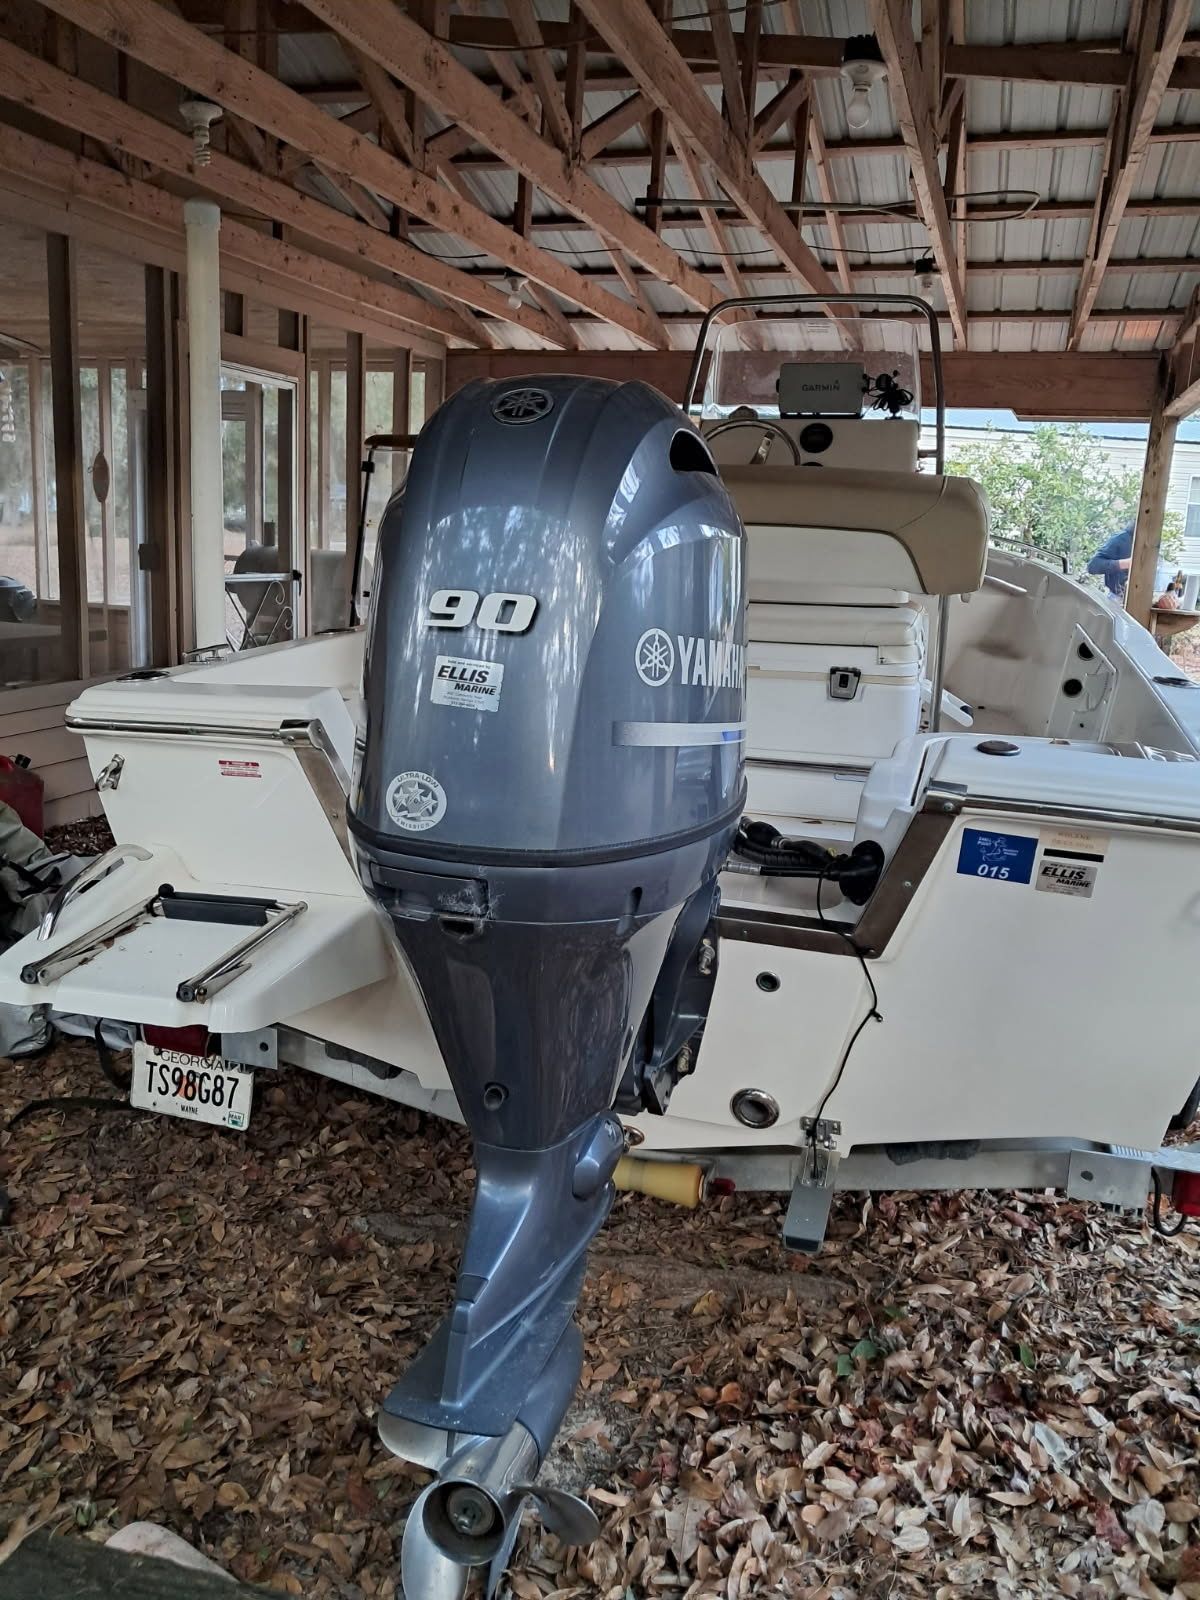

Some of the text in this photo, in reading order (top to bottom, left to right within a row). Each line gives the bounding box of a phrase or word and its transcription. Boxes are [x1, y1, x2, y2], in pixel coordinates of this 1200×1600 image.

[801, 384, 840, 392] GARMIN
[423, 589, 538, 634] 90
[437, 665, 489, 683] ELLIS
[454, 683, 497, 696] MARINE
[977, 864, 1011, 879] 015
[1041, 866, 1086, 880] ELLIS
[1055, 878, 1093, 888] MARINE
[160, 1050, 225, 1072] GEORGIA
[145, 1060, 240, 1109] TS98G87
[180, 1104, 199, 1115] WAYNE
